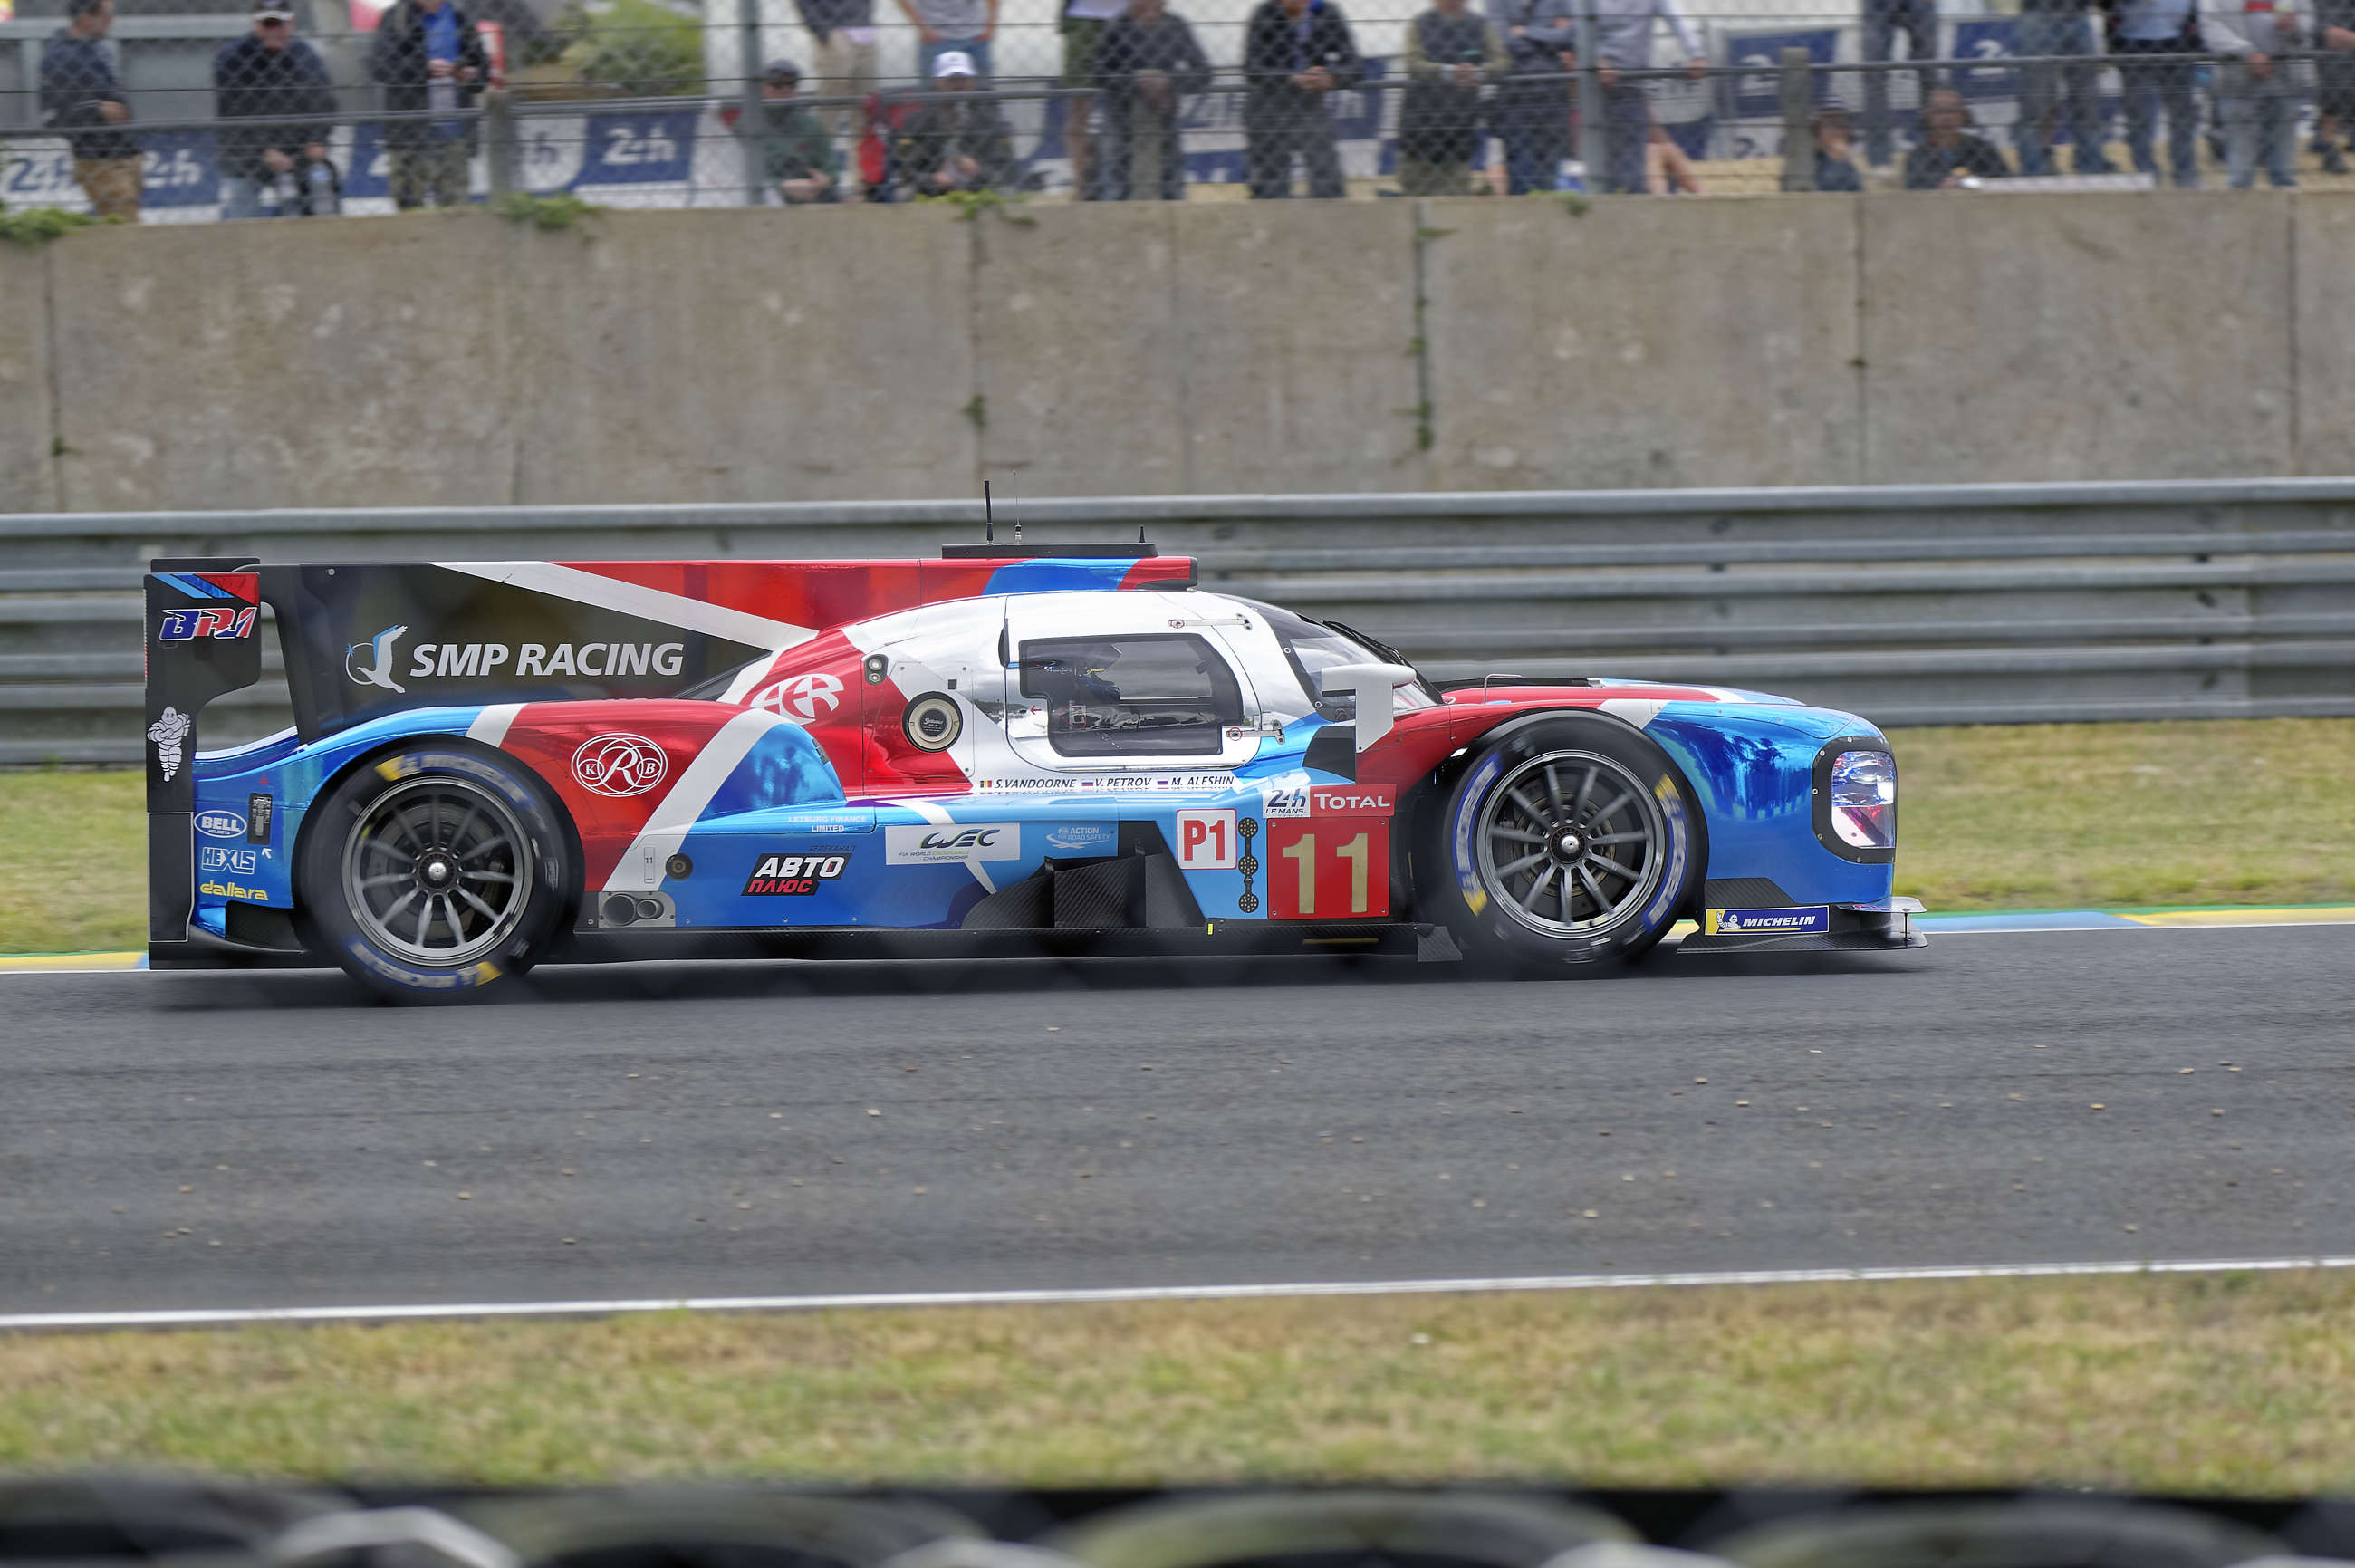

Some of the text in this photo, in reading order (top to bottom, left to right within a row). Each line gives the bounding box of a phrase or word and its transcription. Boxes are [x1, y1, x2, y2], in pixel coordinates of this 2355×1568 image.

[409, 642, 684, 677] SMP RACING
[995, 779, 1077, 789] S.VANDOORNE
[1095, 778, 1152, 787] V. PETROV
[1187, 776, 1234, 786] ALESHIN
[1313, 794, 1391, 810] TOTAL
[201, 816, 241, 832] BELL
[919, 829, 1001, 849] WEC
[1183, 820, 1225, 861] P1
[201, 847, 255, 875] HEXIS
[1283, 832, 1369, 914] 11
[200, 880, 269, 900] dallara
[1743, 915, 1816, 927] MICHELIN
